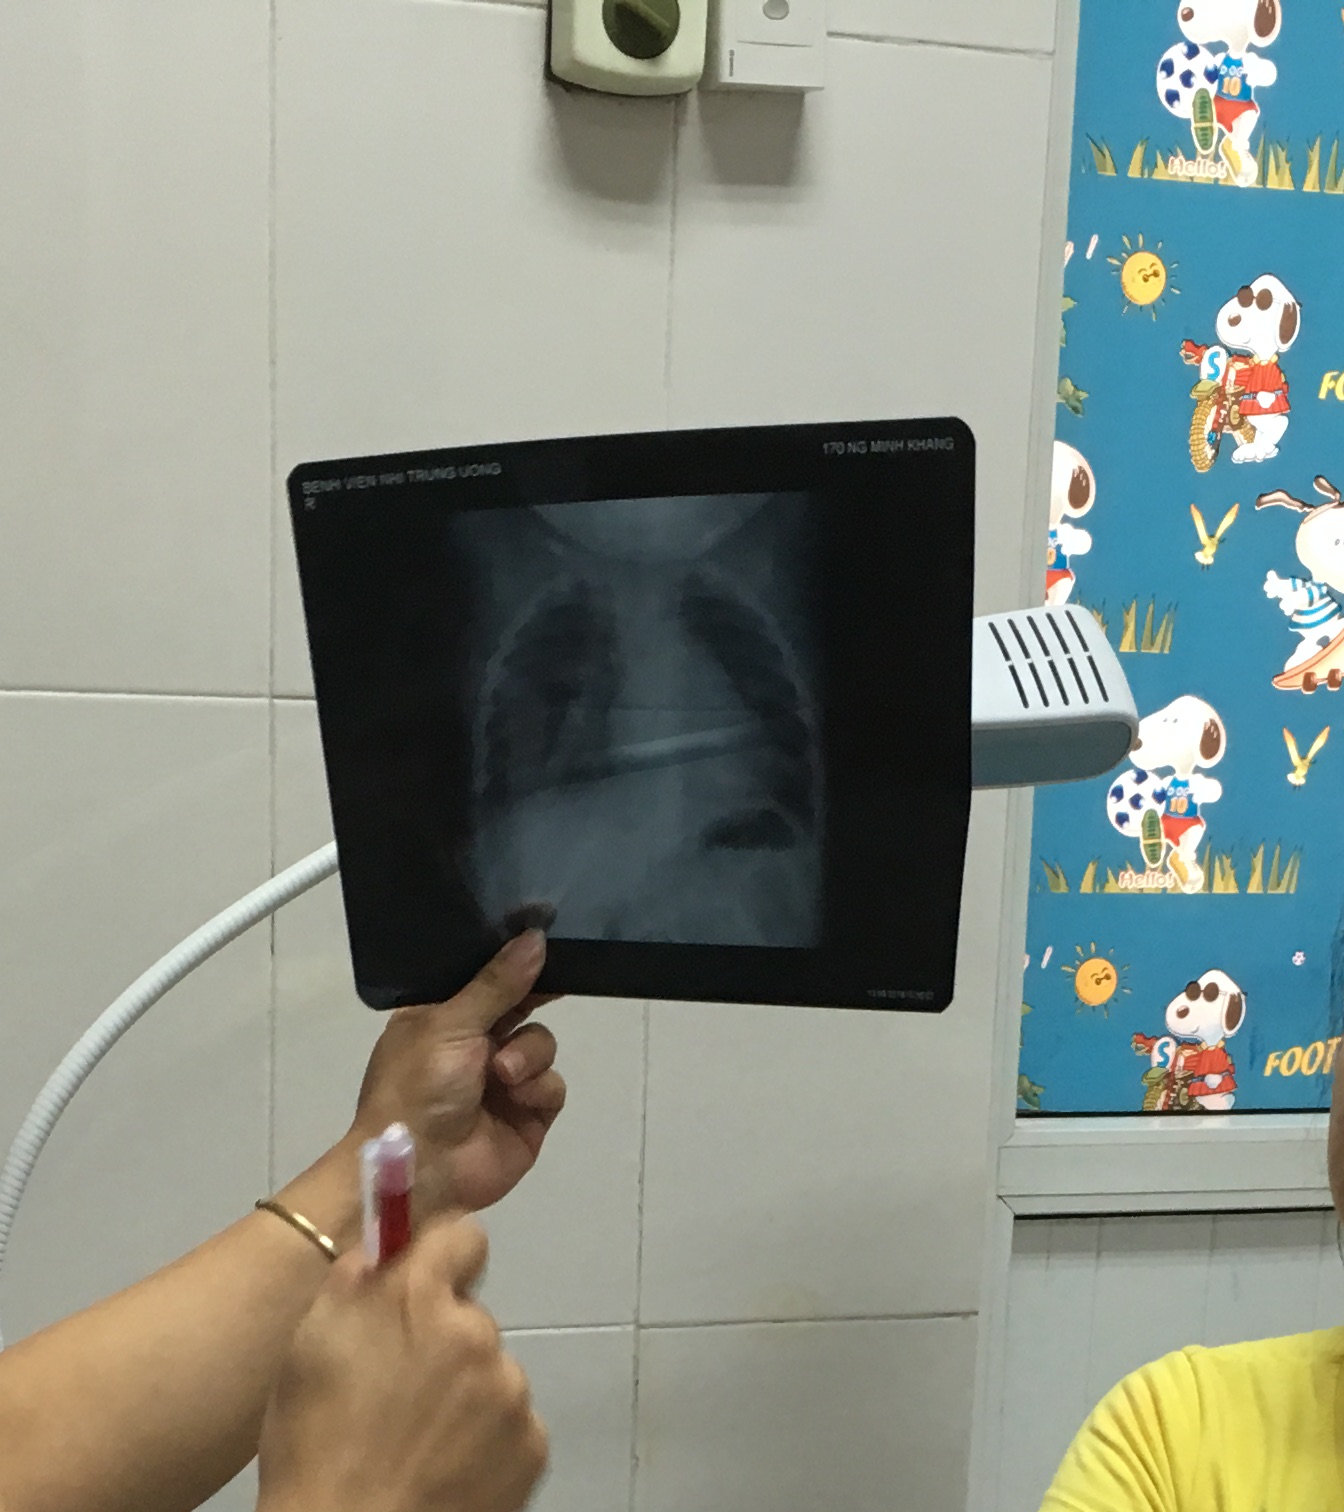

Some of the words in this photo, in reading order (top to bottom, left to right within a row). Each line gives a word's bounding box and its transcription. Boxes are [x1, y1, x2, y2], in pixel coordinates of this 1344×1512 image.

[1168, 155, 1227, 179] Hello!
[907, 436, 955, 451] KHANG
[1118, 870, 1176, 889] Hello!
